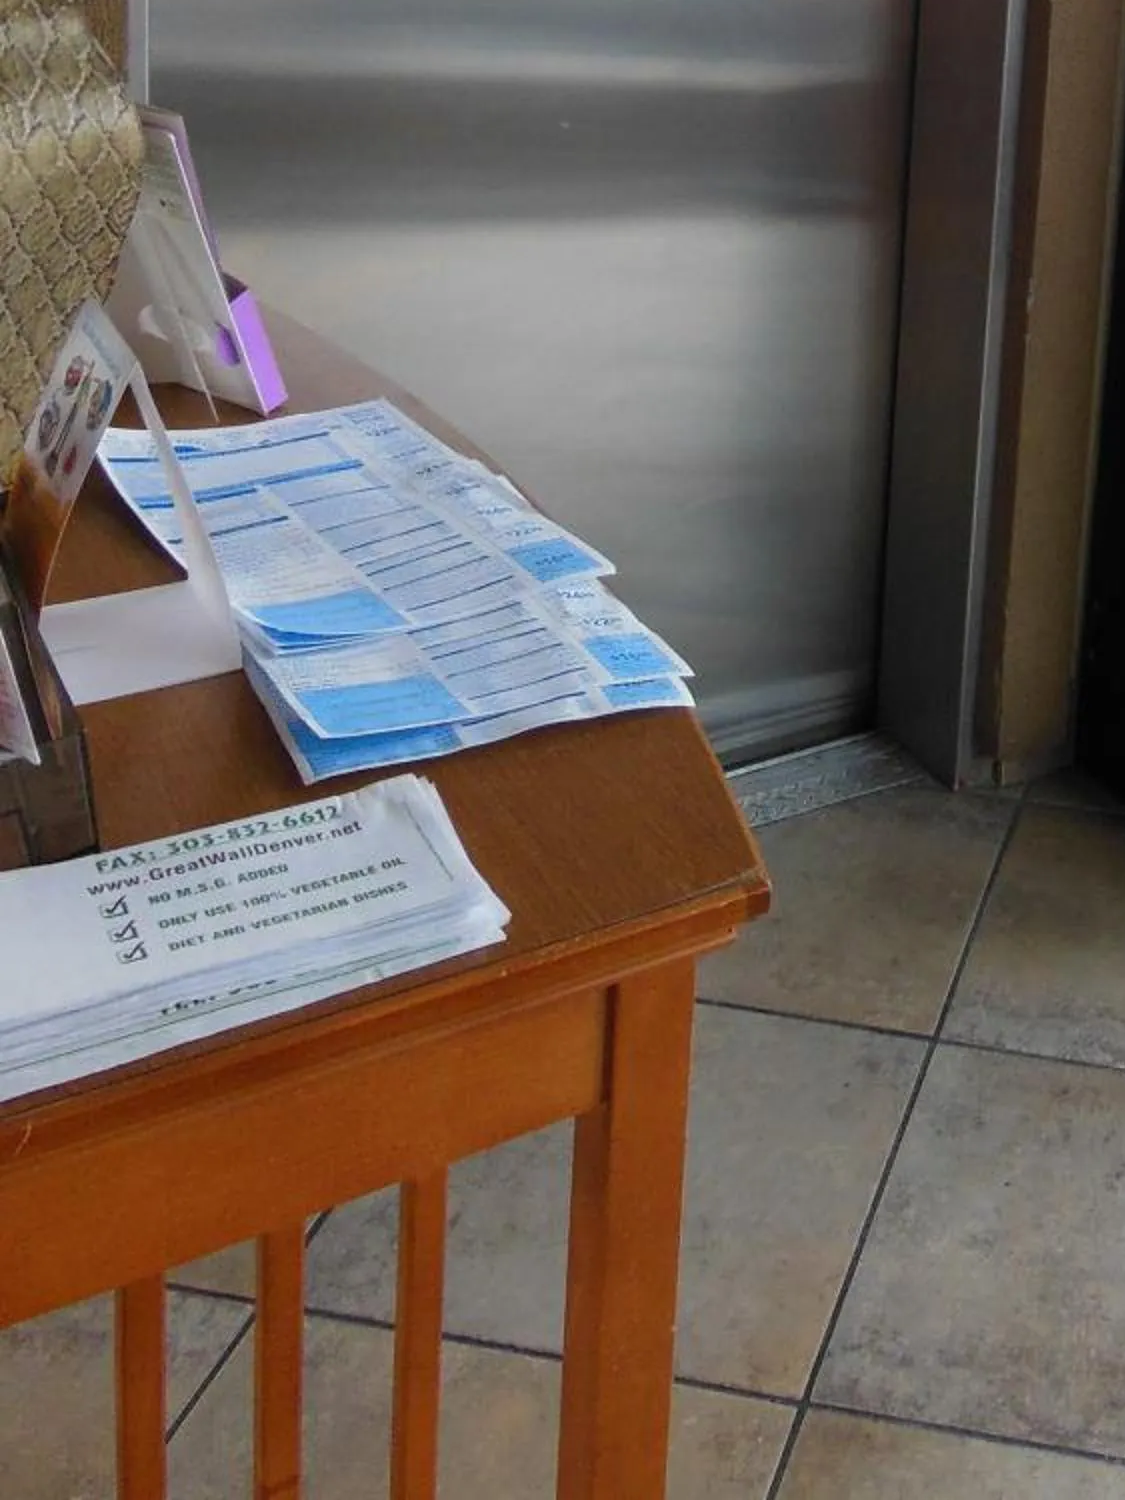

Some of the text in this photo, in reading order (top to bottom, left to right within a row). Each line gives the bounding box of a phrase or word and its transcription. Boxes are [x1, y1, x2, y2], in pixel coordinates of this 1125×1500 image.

[86, 820, 363, 896] www.GreatWallDenver.net
[95, 804, 343, 875] FAX: 303-832-6612
[148, 863, 289, 905] NO M.S.G. ADDED
[157, 856, 408, 930] ONLY USE 100% VEGETABLE OIL
[168, 881, 408, 951] DIET AND VEGETARIAN DISHES
